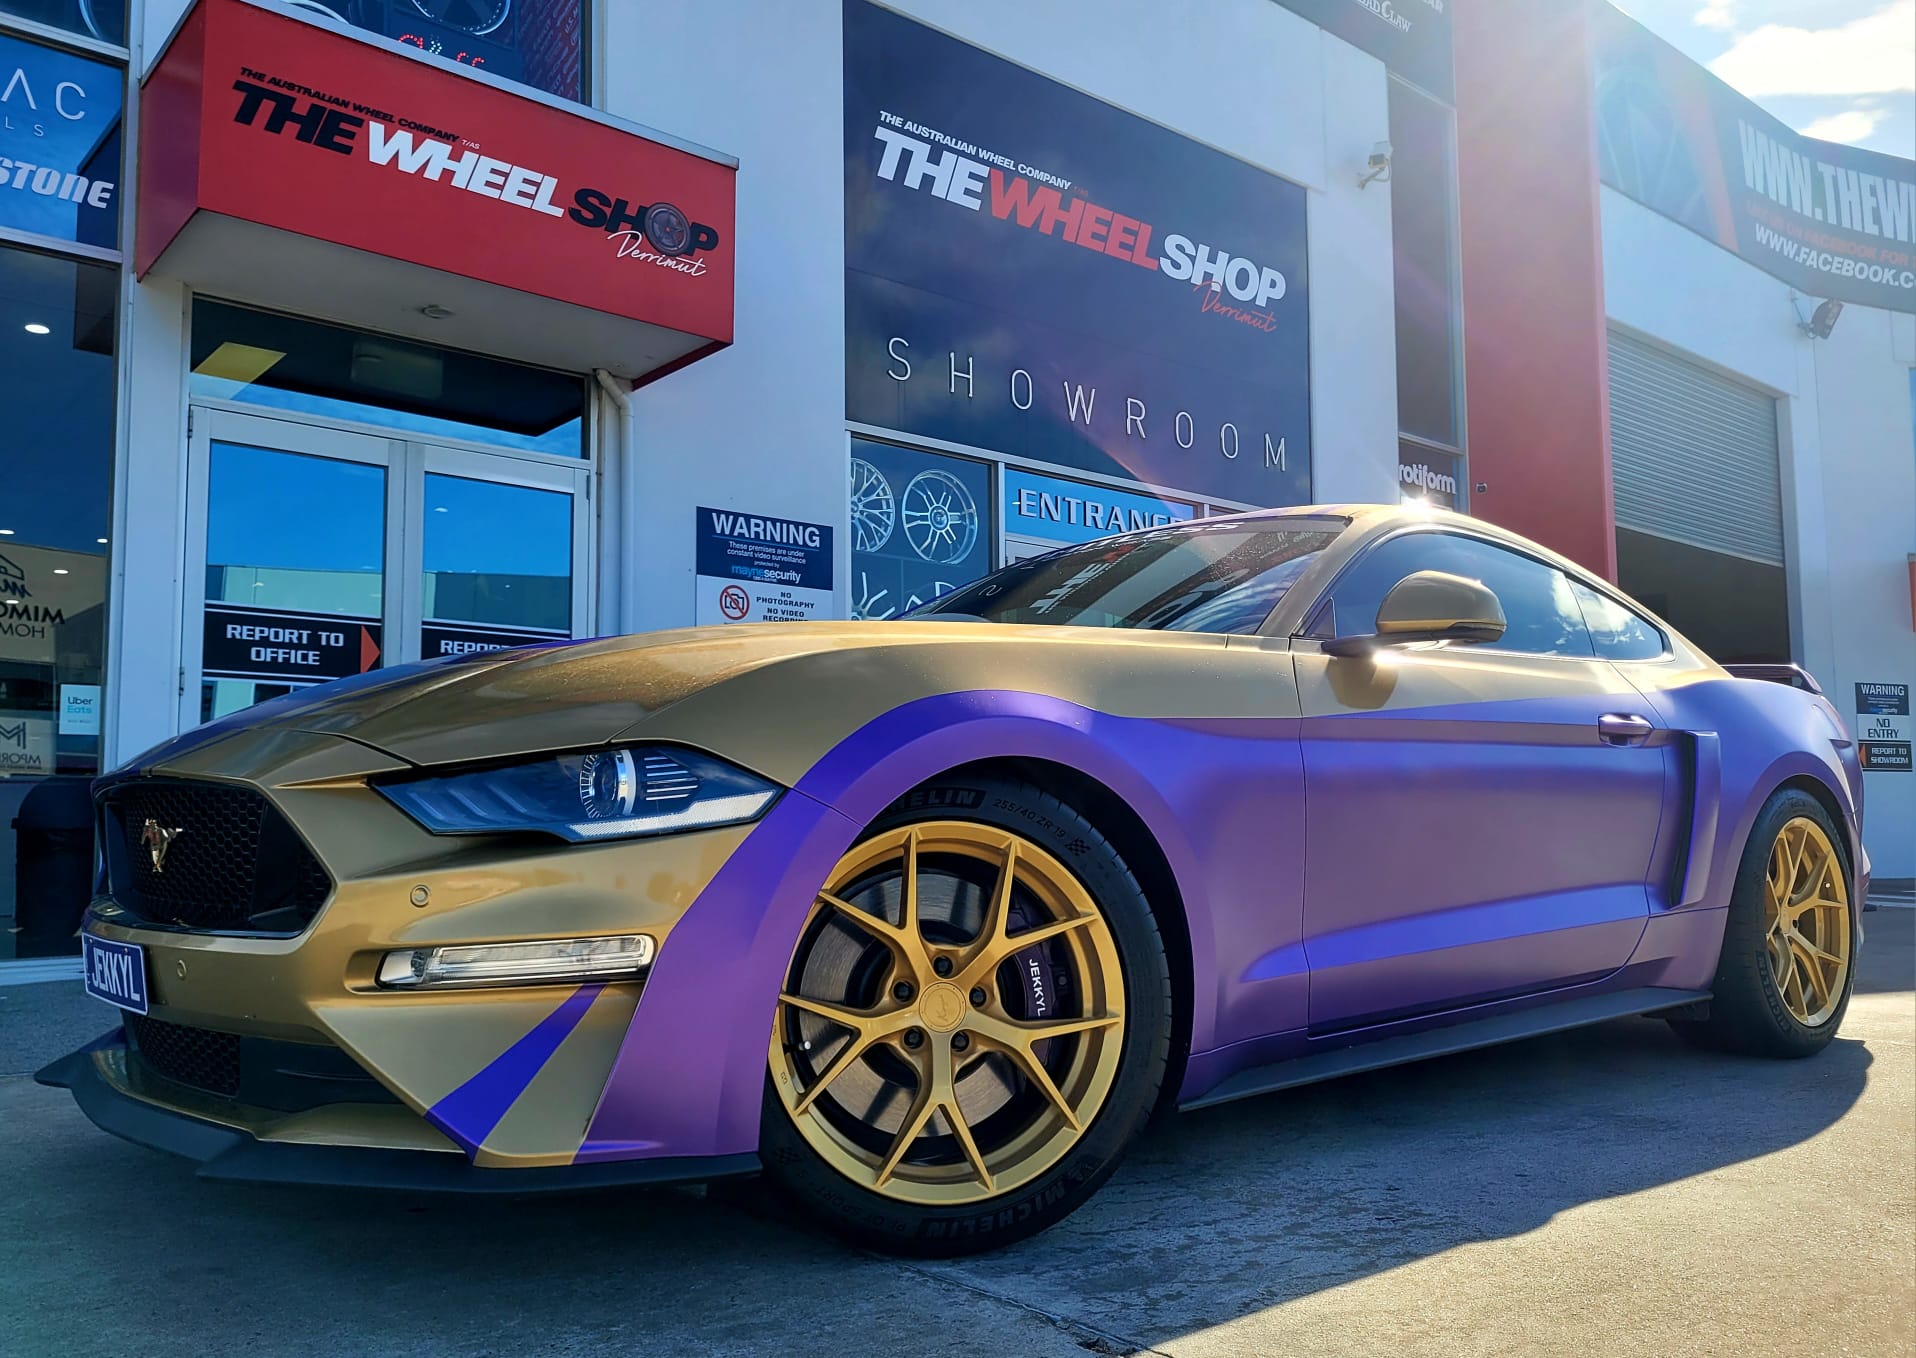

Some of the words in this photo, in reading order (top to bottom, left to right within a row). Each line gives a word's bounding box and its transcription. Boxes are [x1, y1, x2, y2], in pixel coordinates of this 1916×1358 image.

[240, 66, 266, 82] THE
[267, 77, 351, 109] AUSTRALIAN
[352, 102, 396, 124] WHEEL
[398, 117, 460, 143] COMPANY
[232, 79, 365, 156] THE
[368, 120, 565, 218] WHEEL
[880, 110, 904, 128] THE
[904, 120, 977, 155] AUSTRALIAN
[978, 148, 1016, 171] WHEEL
[1018, 163, 1072, 190] COMPANY
[1738, 119, 1916, 244] WWW.THEW
[874, 126, 990, 211] THE
[989, 167, 1159, 271] WHEEL
[1159, 233, 1287, 307] SHOP
[607, 230, 707, 277] Derrimut
[1755, 223, 1916, 288] WWW.FACEBOOK.C
[1194, 280, 1278, 333] Derrimut
[888, 336, 1286, 472] SHOWROOM
[712, 512, 820, 548] WARNING
[727, 549, 753, 558] constant
[754, 551, 771, 560] video
[729, 541, 748, 551] These
[748, 545, 776, 555] premises
[777, 548, 787, 556] are
[787, 549, 804, 558] under
[756, 596, 815, 609] PHOTOGRAPHY
[780, 591, 792, 599] NO
[767, 607, 779, 615] NO
[780, 609, 805, 618] VIDEO
[226, 624, 309, 645] REPORT
[319, 629, 345, 648] TO
[440, 639, 509, 655] REPO
[250, 646, 320, 666] OFFICE
[67, 696, 93, 705] Uber
[1861, 683, 1905, 696] WARNING
[66, 705, 92, 714] Eats
[1867, 728, 1899, 739] ENTRY
[1876, 718, 1890, 728] NO
[1870, 756, 1909, 764] SHOWROOM
[1871, 747, 1896, 755] REPORT
[992, 798, 1035, 821] 255/40
[1036, 813, 1053, 829] ZR
[1055, 826, 1067, 839] 19
[91, 946, 141, 1002] JEKKYL
[1029, 958, 1046, 1017] JEKKYL
